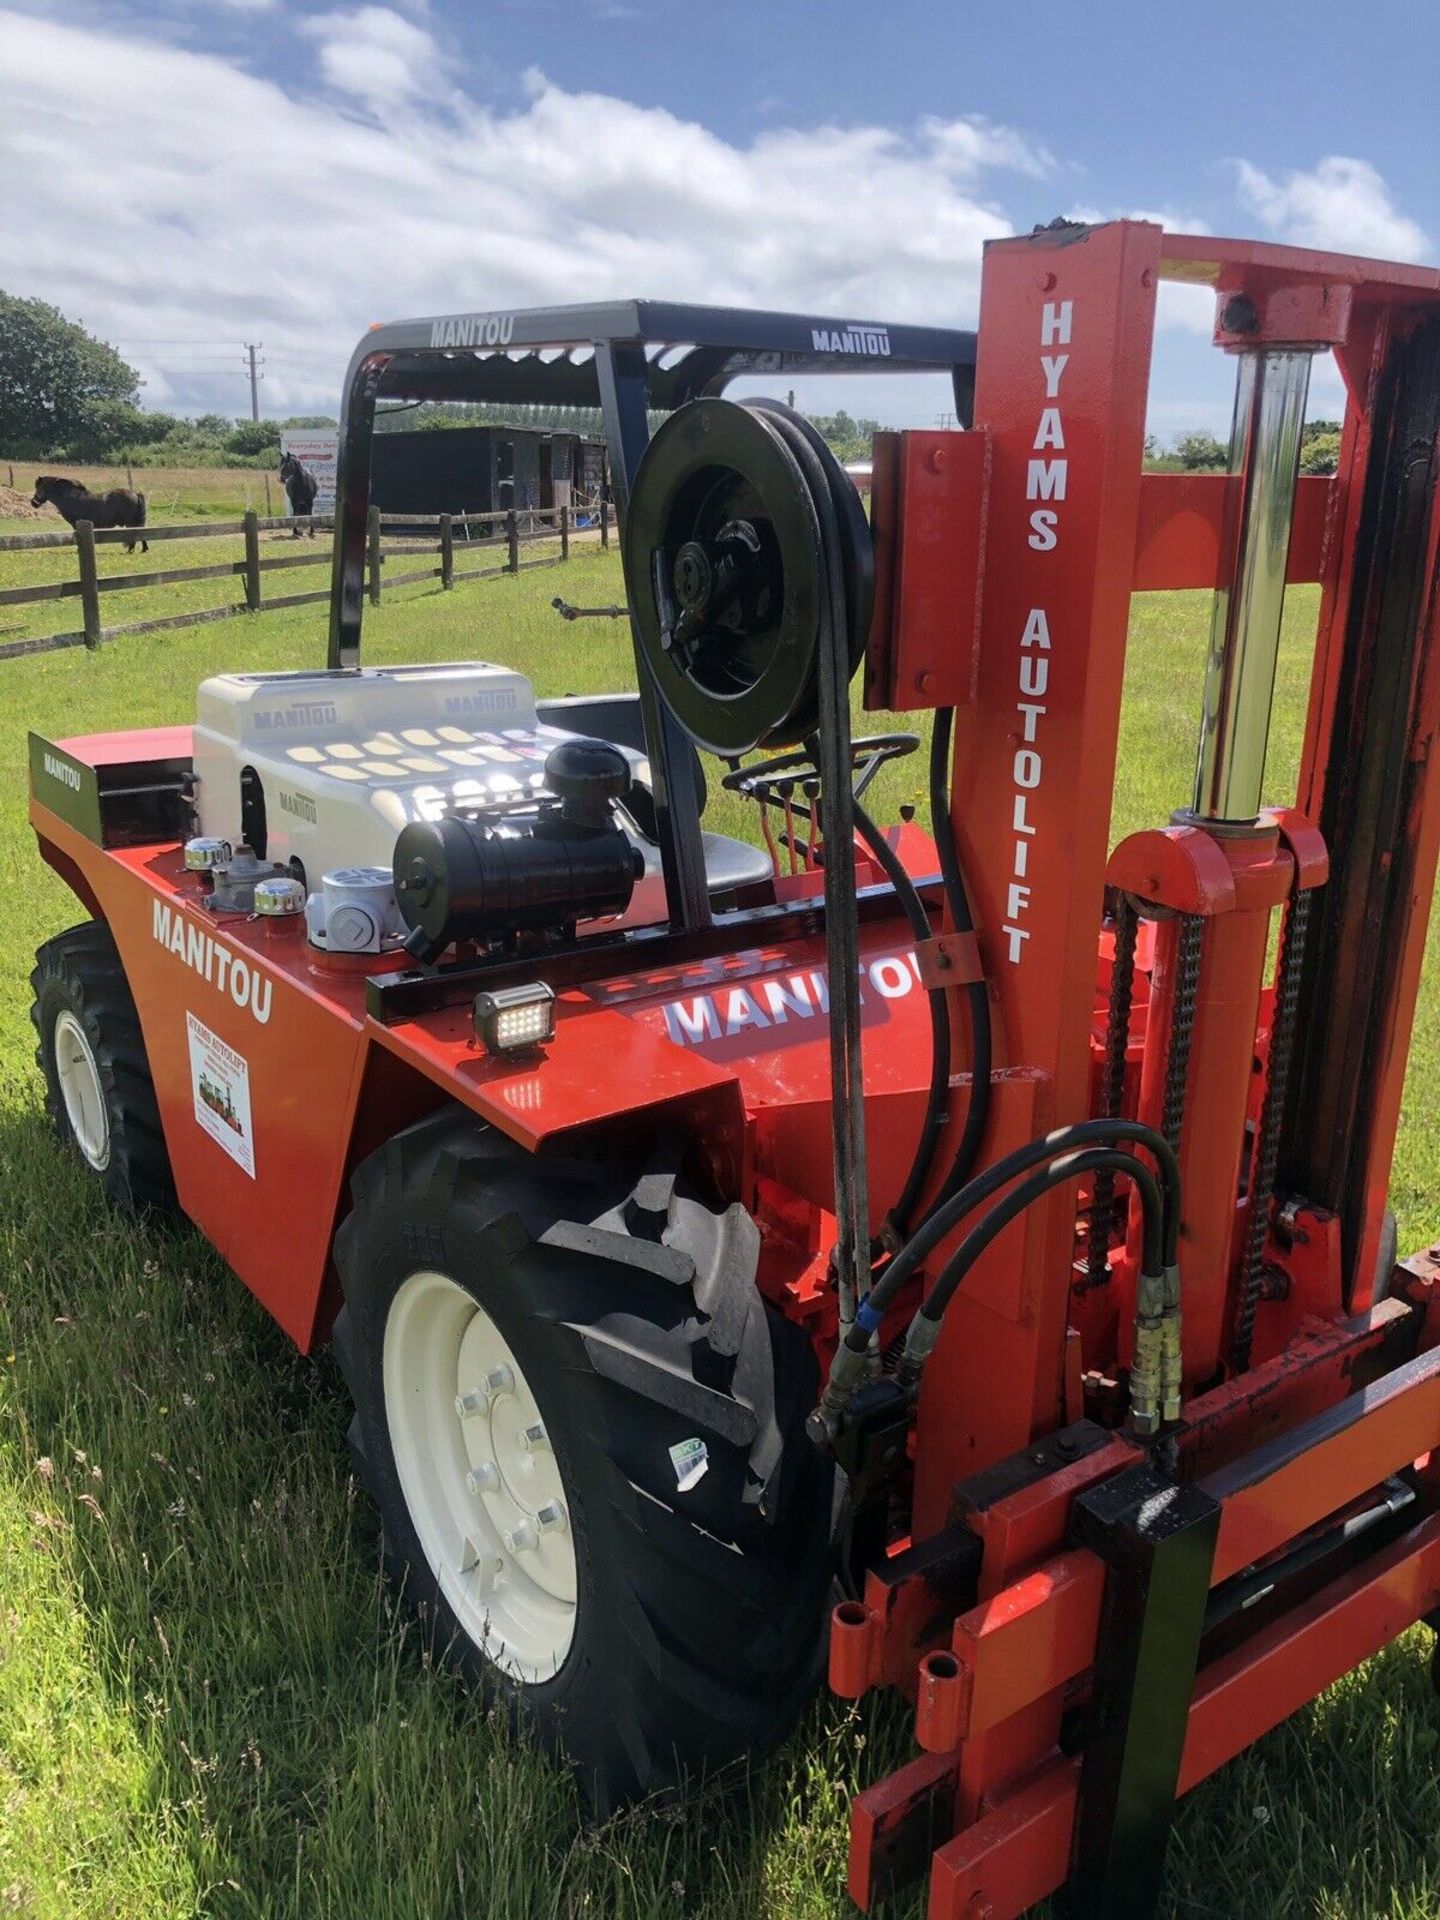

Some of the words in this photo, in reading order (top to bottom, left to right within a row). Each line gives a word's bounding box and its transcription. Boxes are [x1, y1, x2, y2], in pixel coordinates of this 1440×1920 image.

[430, 316, 515, 348] MANITOU
[811, 325, 891, 356] MANITOU
[1026, 301, 1074, 551] HYAMS
[254, 700, 337, 730] MANITOU
[445, 688, 518, 713] MANITOU
[44, 752, 81, 792] MANITOU
[1002, 608, 1051, 964] AUTOLIFT
[279, 792, 318, 825] MANITOU
[153, 898, 273, 1024] MANITOU
[662, 951, 923, 1047] MANIO
